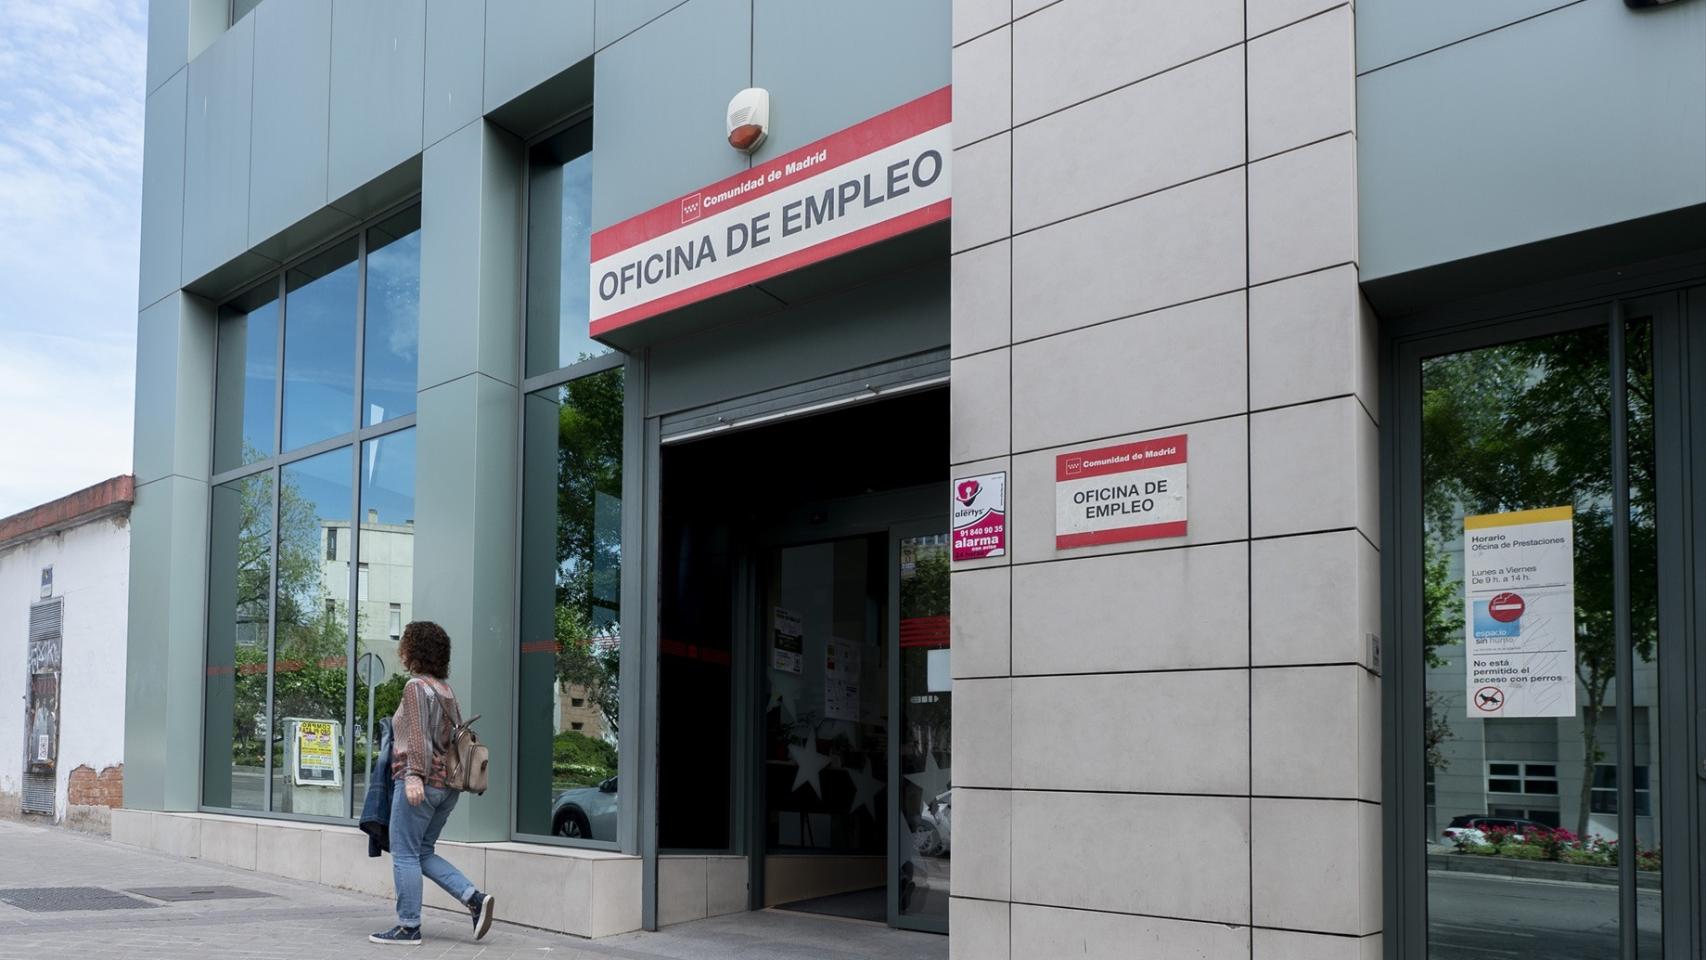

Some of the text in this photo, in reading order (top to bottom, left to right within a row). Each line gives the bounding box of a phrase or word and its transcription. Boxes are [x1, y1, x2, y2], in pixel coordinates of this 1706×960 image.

[703, 150, 827, 208] Comunidad de Madrid
[599, 149, 942, 301] OFICINA DE EMPLEO
[1083, 447, 1176, 469] Comunidad de Madrid
[1073, 479, 1168, 504] OFICINA DE
[1086, 498, 1154, 519] EMPLEO
[970, 528, 983, 536] 840
[994, 525, 1003, 533] 35
[955, 535, 999, 548] alarma
[1472, 534, 1506, 543] Horario
[1472, 542, 1499, 551] Oficina
[1513, 537, 1565, 548] Prestaciones
[1475, 630, 1507, 638] espacio
[1473, 667, 1518, 676] permitido
[1530, 675, 1562, 683] perros
